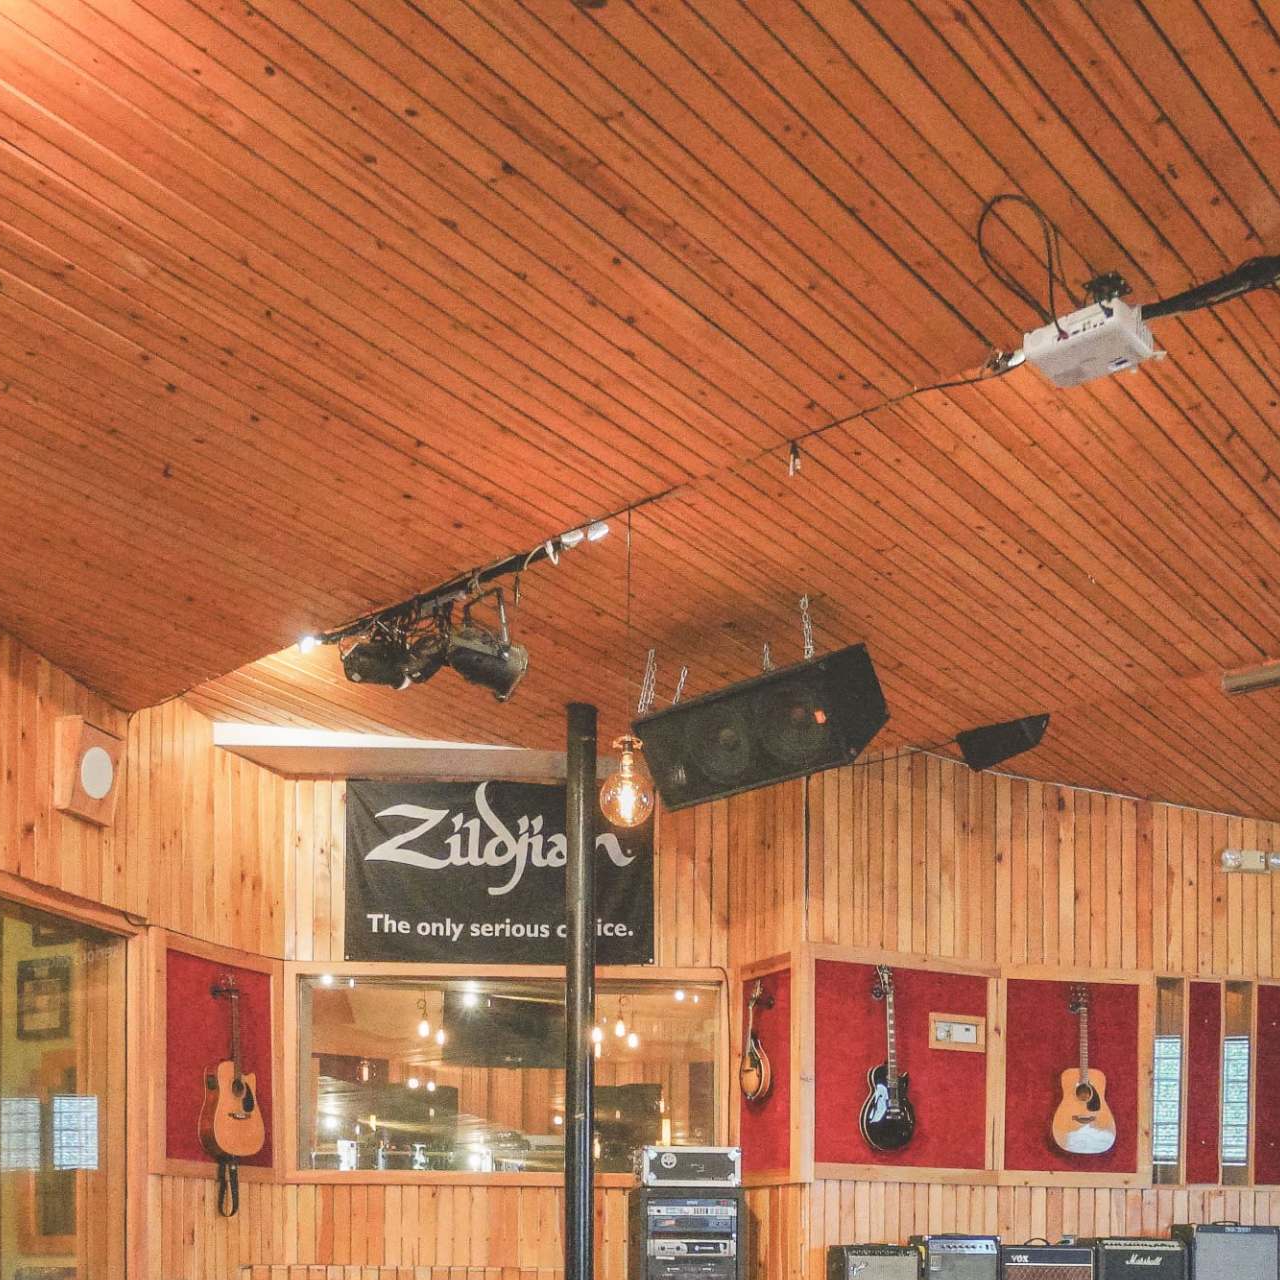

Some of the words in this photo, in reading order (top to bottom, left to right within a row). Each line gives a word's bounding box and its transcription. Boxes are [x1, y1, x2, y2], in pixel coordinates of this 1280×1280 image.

[364, 781, 636, 895] Zildjian
[367, 914, 410, 934] The
[417, 918, 464, 941] only
[470, 918, 550, 938] serious
[557, 918, 634, 938] cice.
[1011, 1254, 1029, 1263] VOX
